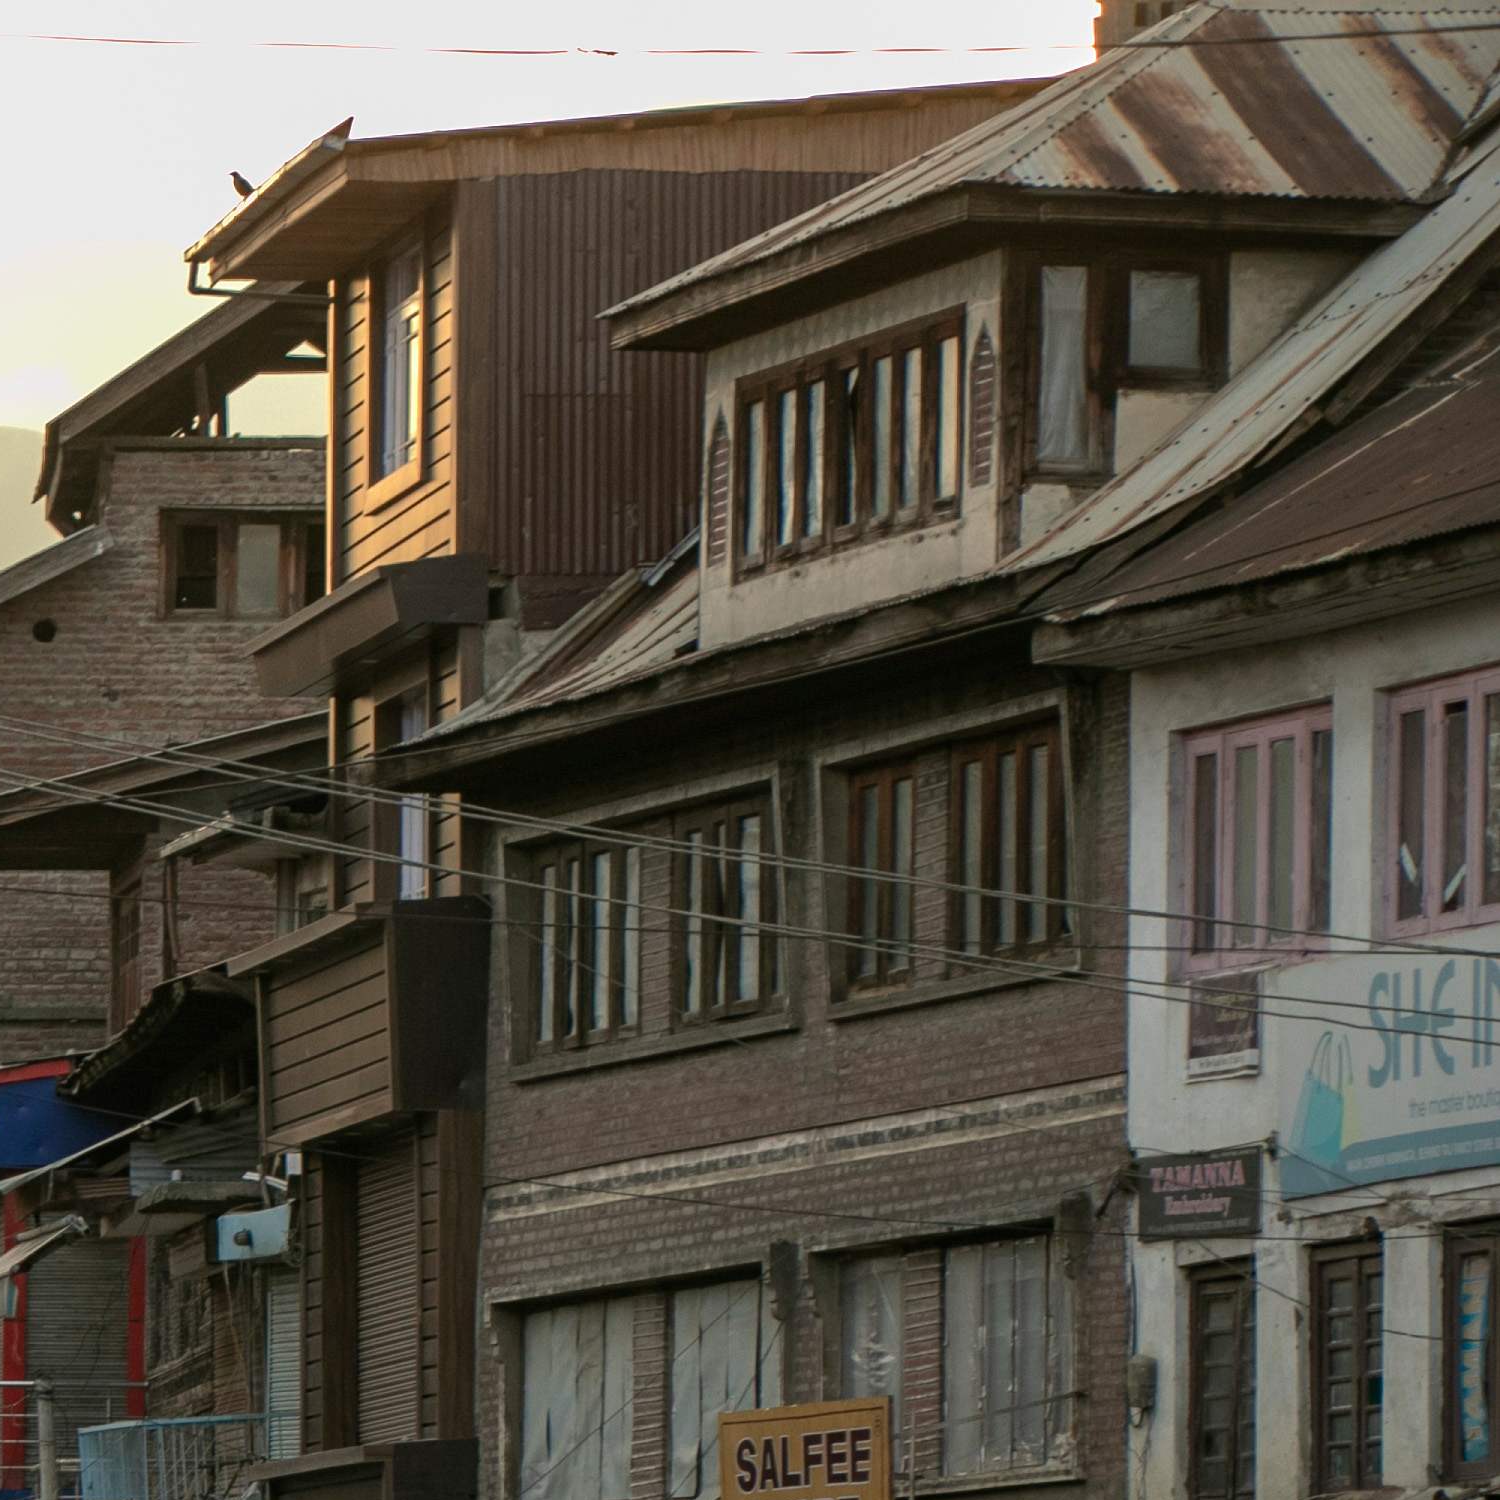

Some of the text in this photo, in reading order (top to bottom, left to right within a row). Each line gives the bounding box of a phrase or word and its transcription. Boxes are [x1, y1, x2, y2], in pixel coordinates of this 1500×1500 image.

[1368, 958, 1455, 1088] SHE
[1150, 1159, 1246, 1193] TAMANNA
[735, 1426, 871, 1494] SALFEE
